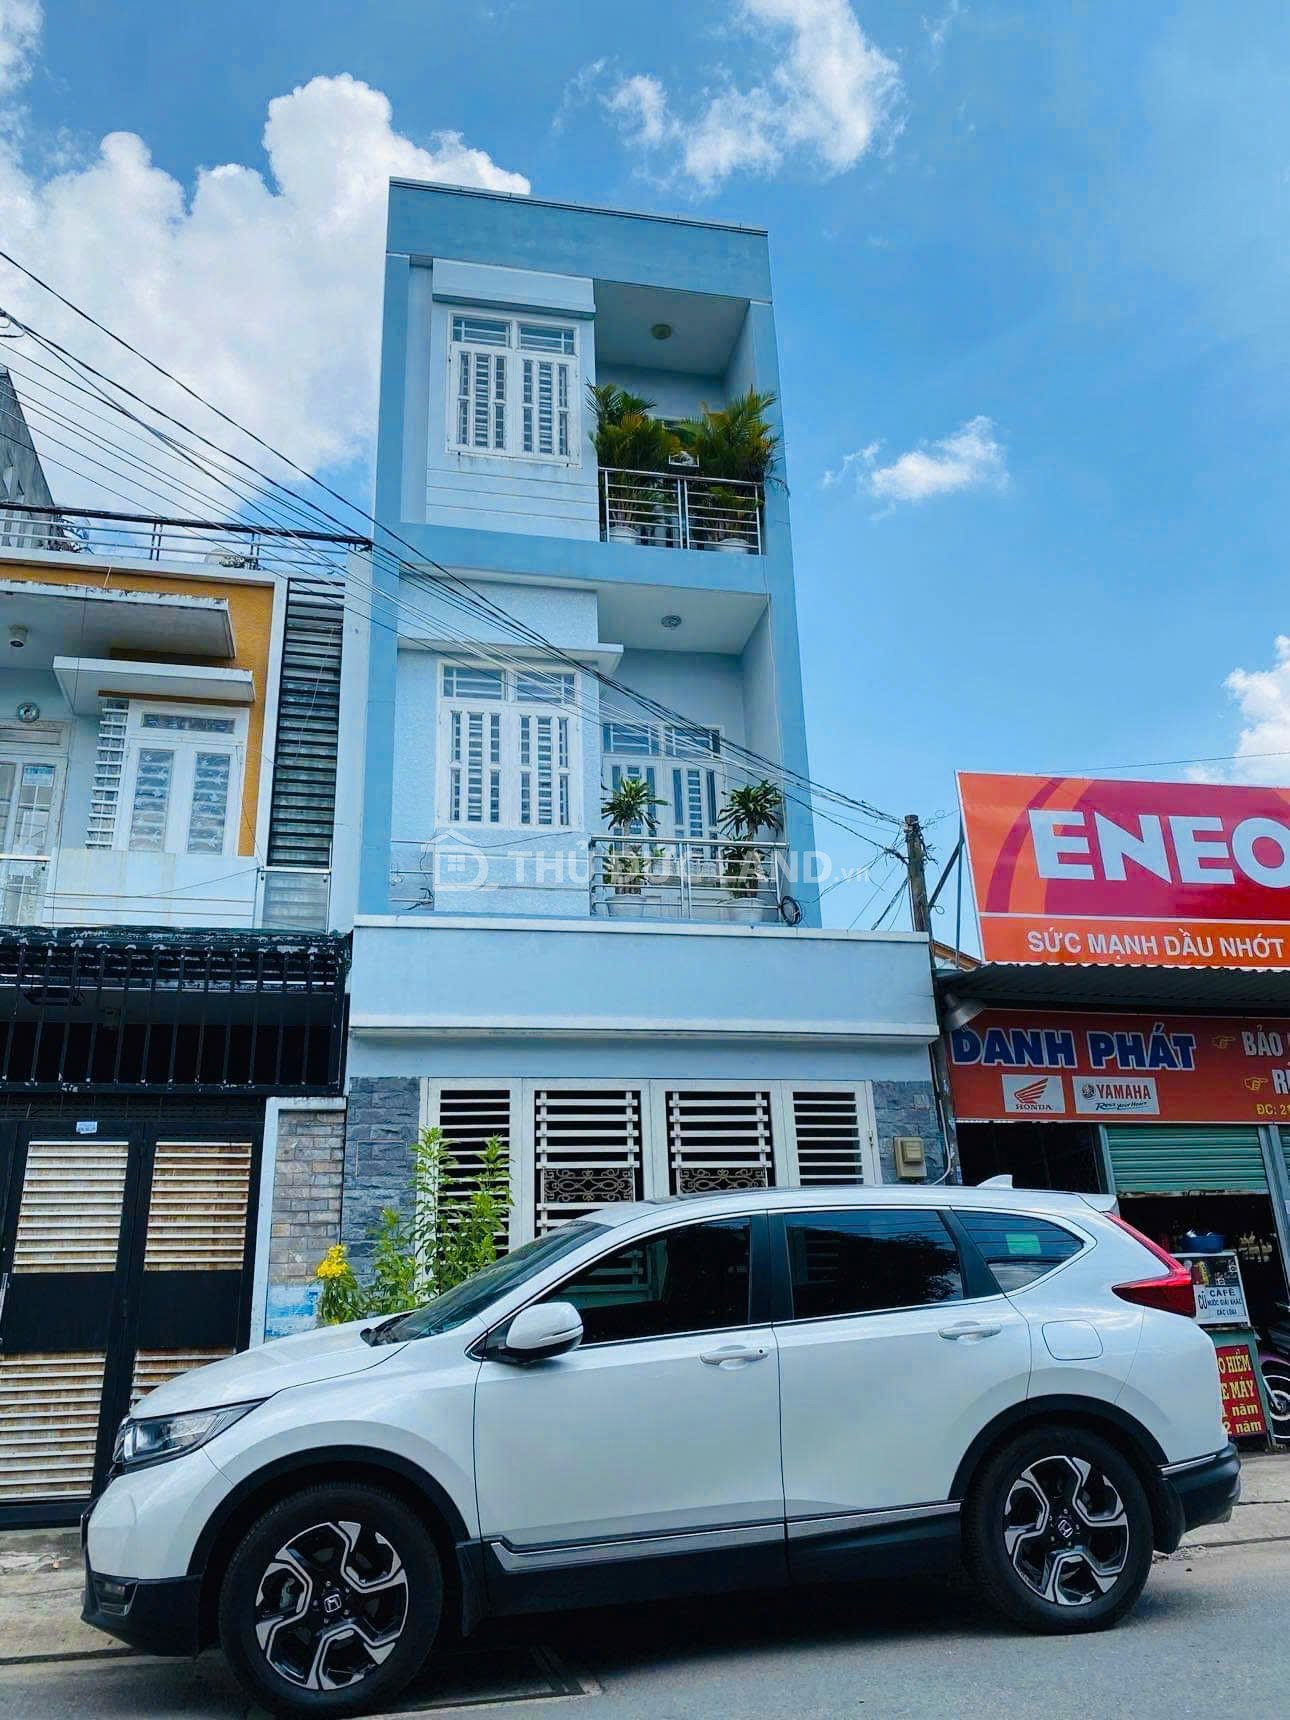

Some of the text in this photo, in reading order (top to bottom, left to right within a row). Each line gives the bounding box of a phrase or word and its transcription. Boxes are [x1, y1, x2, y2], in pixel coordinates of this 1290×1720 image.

[1028, 809, 1290, 889] ENEO
[1027, 927, 1284, 960] SỨC MẠNH DẦU NHỚT
[951, 1022, 1196, 1071] DANH PHÁT
[1241, 1024, 1284, 1057] BẢO
[1095, 1084, 1151, 1100] YAMAHA
[1015, 1103, 1053, 1111] HONDA
[1256, 1103, 1278, 1115] ĐC:
[1226, 1348, 1252, 1374] HIỂM
[1221, 1375, 1255, 1400] E MÁY
[1231, 1402, 1259, 1417] năm
[1235, 1420, 1262, 1434] năm
